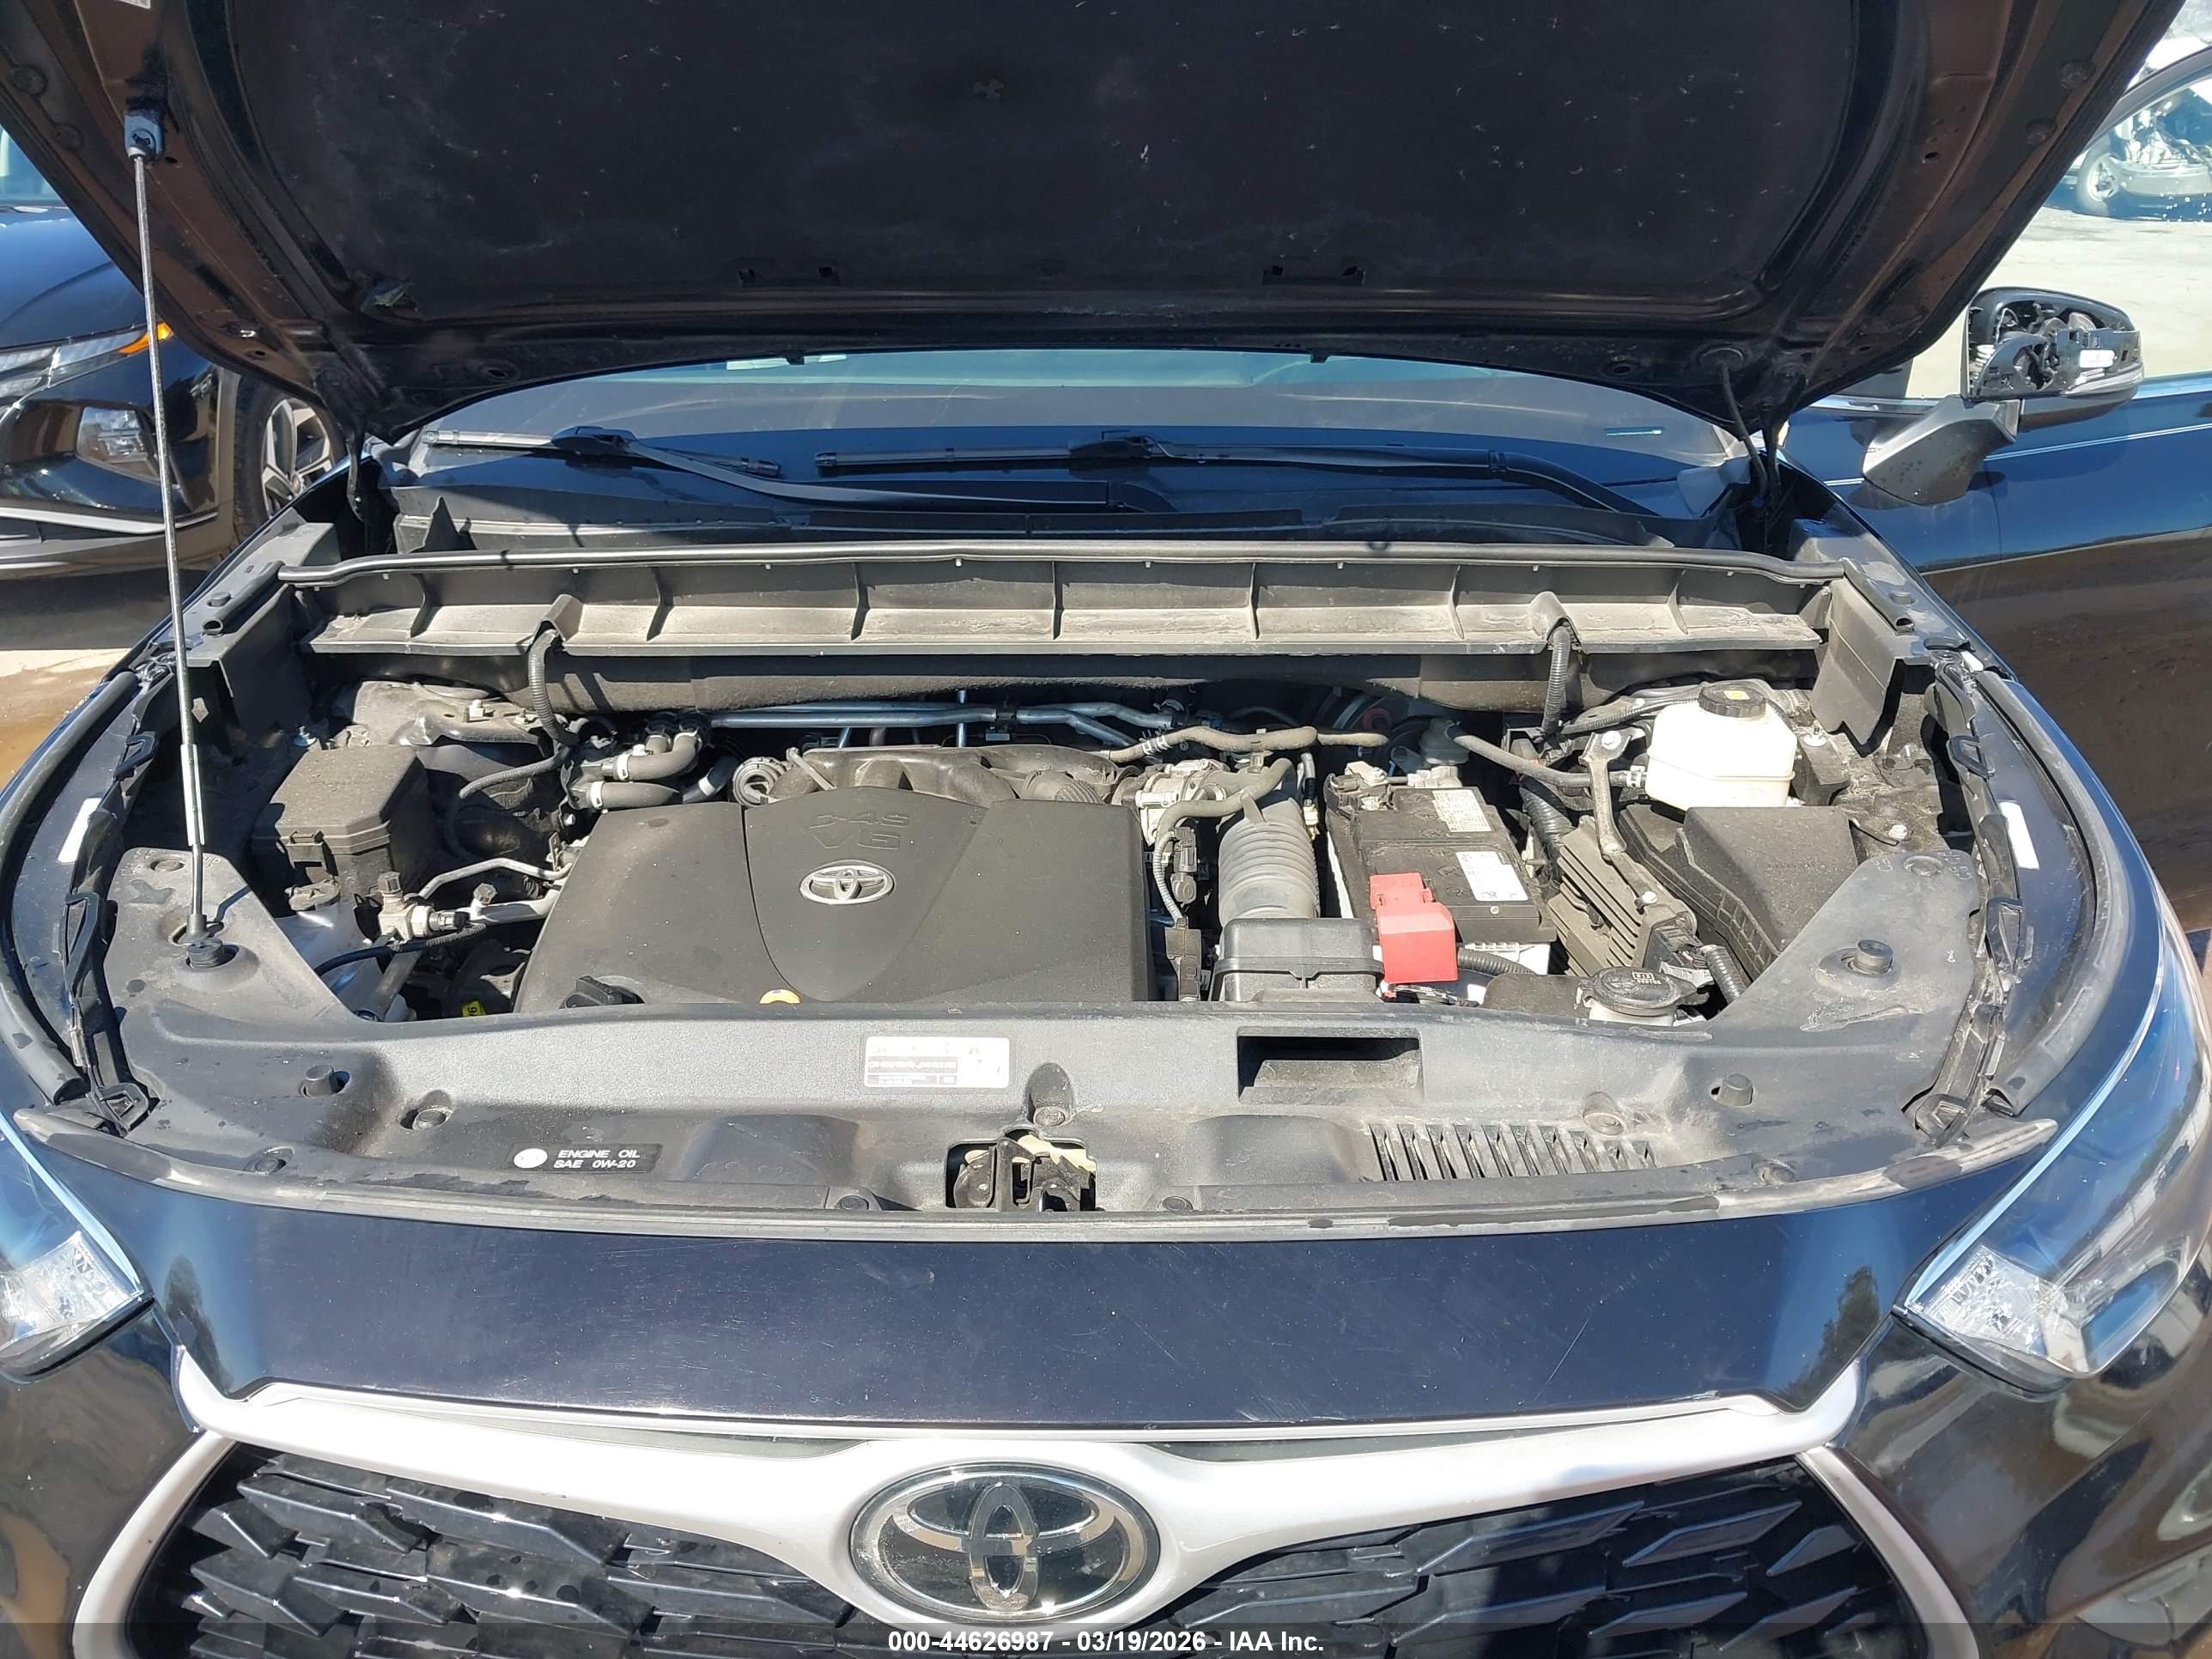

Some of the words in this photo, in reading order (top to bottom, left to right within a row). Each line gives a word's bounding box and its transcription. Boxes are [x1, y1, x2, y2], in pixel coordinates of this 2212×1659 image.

[557, 1149, 611, 1158] ENGINE
[617, 1149, 641, 1158] OIL
[553, 1159, 584, 1169] SAE
[592, 1159, 636, 1169] 0W-20
